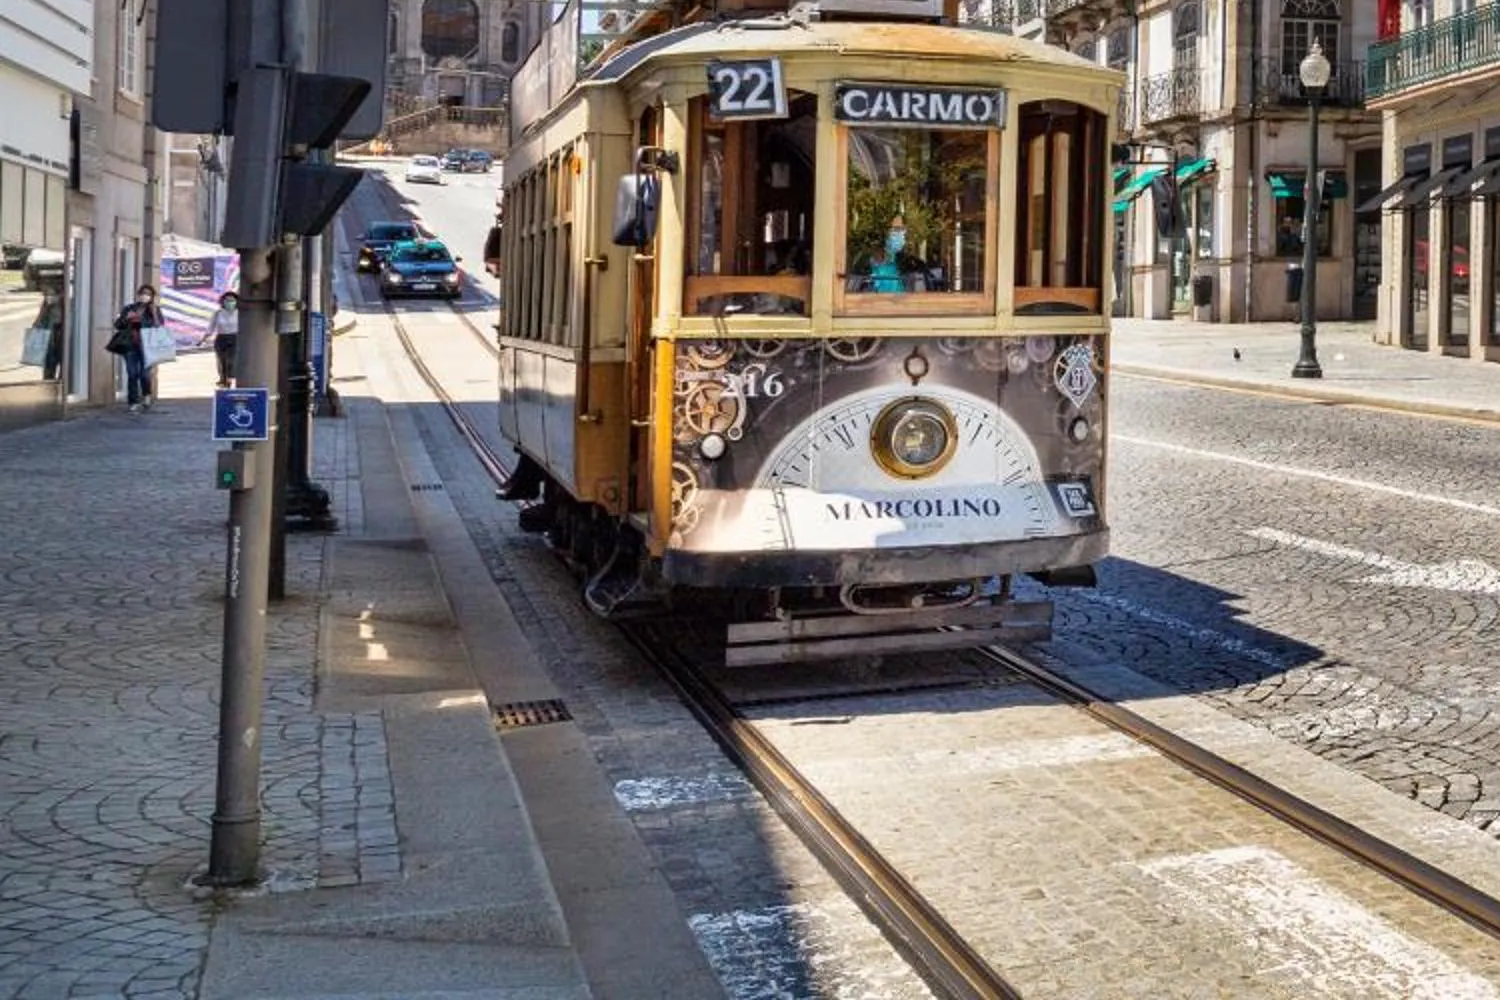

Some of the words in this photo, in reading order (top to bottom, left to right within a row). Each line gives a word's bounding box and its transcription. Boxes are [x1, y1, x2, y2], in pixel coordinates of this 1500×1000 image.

[715, 67, 771, 111] 22
[842, 88, 993, 122] CARMO
[720, 372, 784, 397] 216
[826, 499, 1001, 521] MARCOLINO
